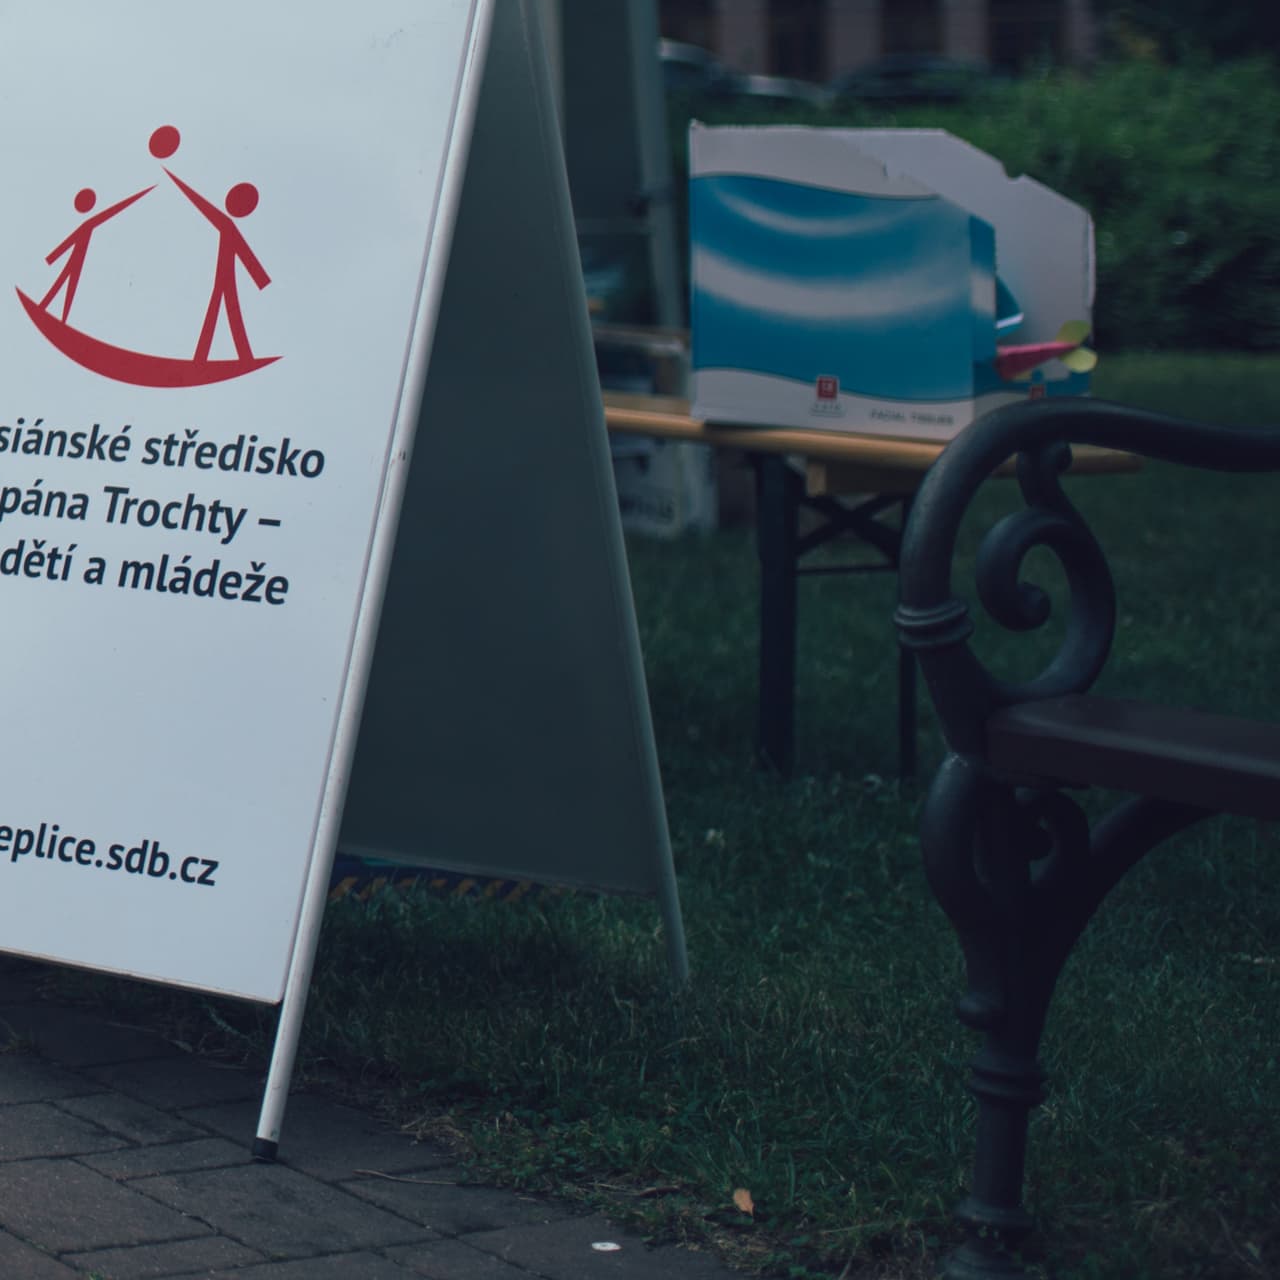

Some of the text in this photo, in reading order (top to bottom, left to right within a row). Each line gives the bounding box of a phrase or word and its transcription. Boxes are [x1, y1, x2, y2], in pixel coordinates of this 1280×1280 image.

[141, 428, 325, 479] středisko
[103, 485, 248, 545] Trochty
[0, 539, 78, 582] dětí
[83, 556, 106, 585] a
[117, 553, 289, 606] mládeže
